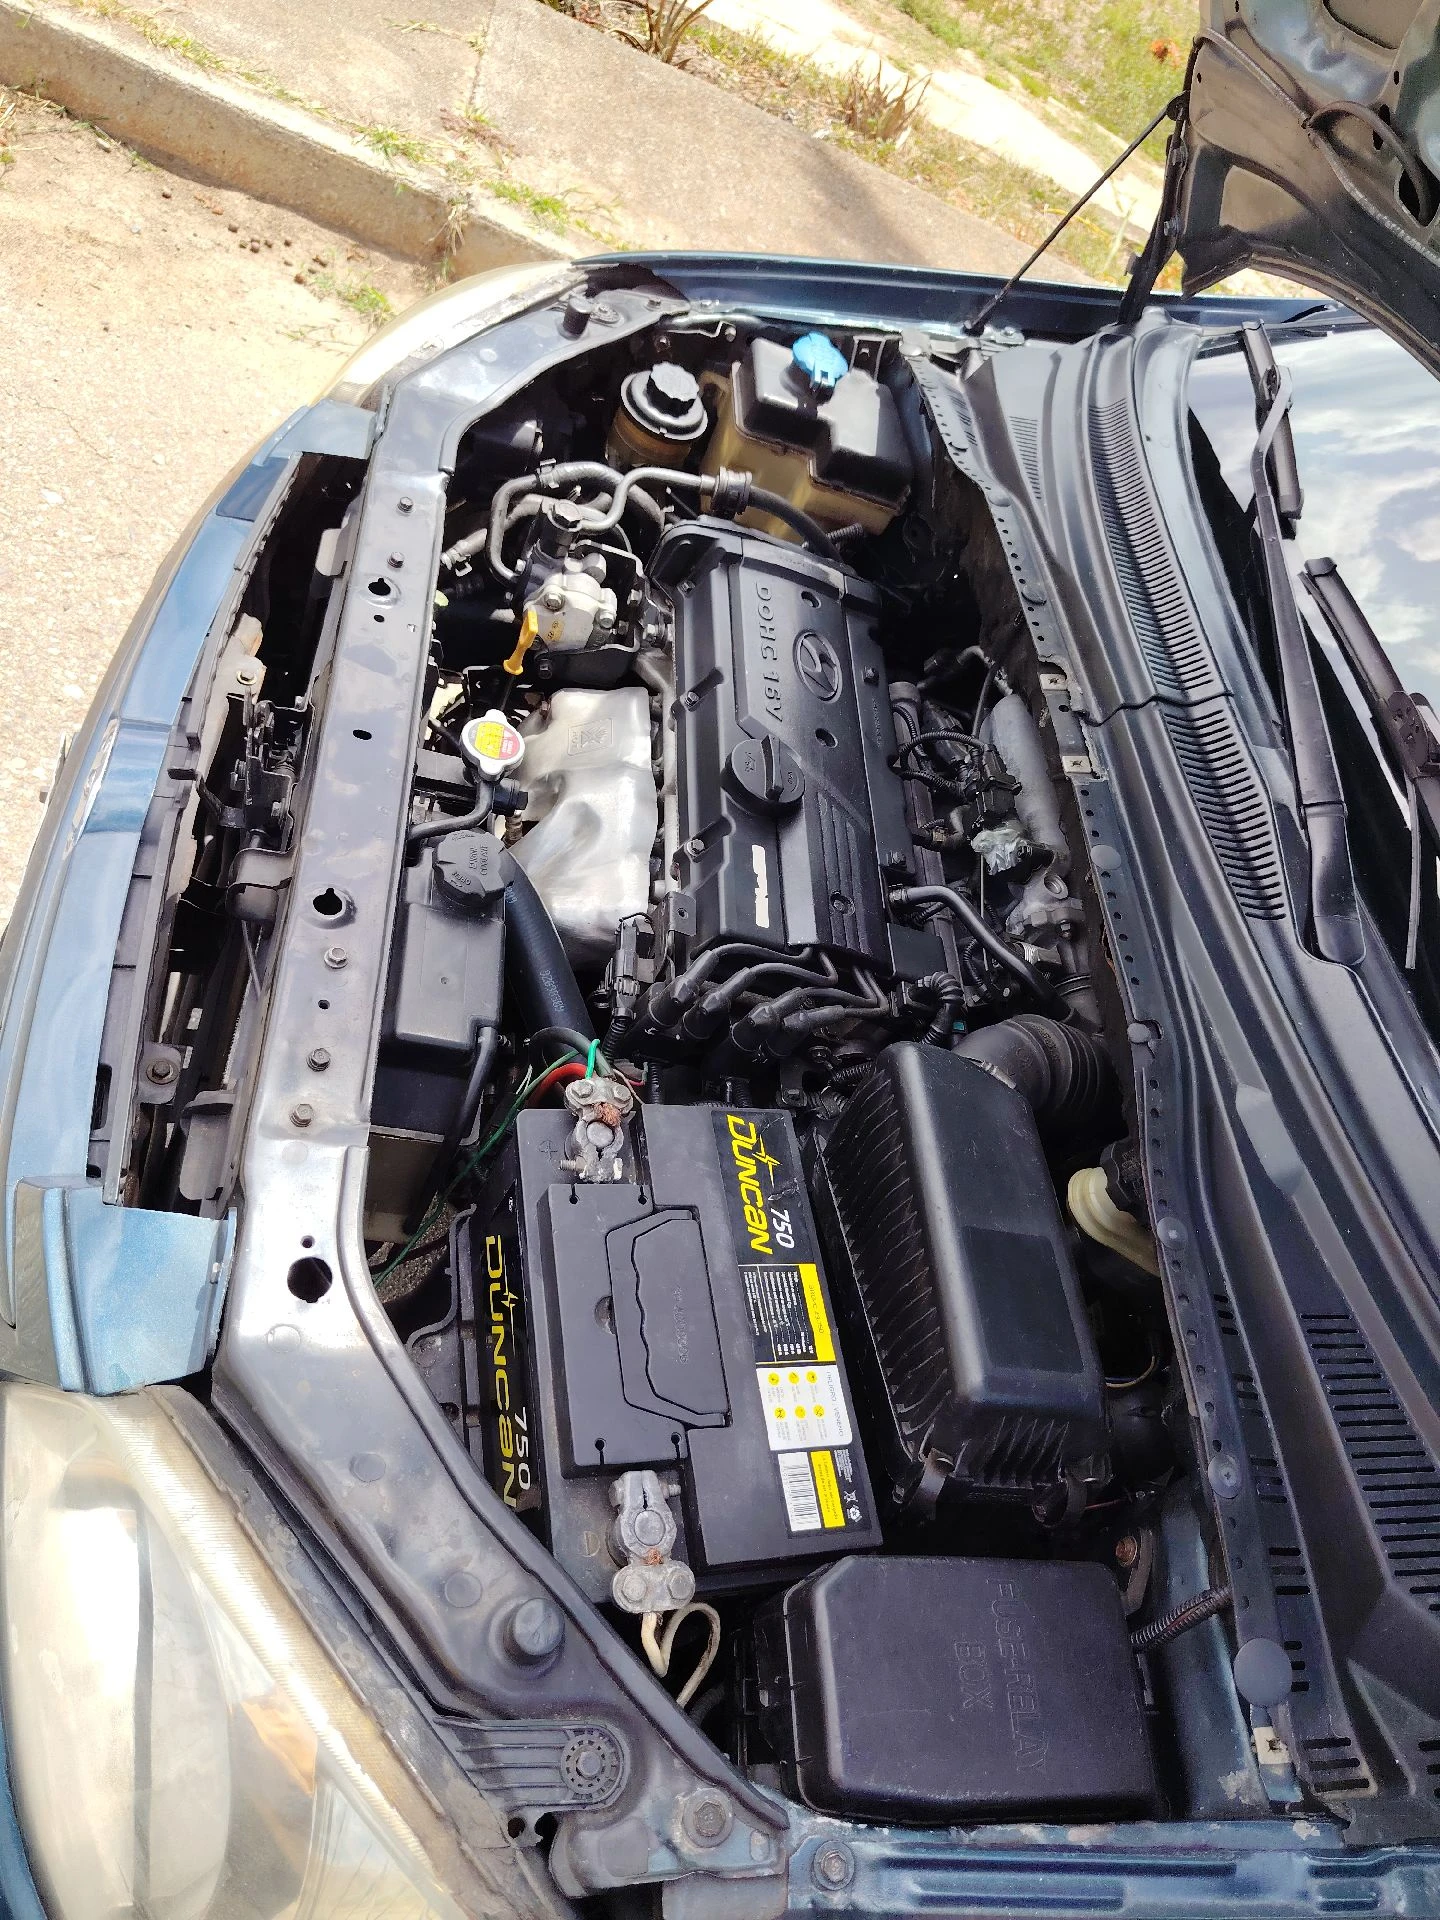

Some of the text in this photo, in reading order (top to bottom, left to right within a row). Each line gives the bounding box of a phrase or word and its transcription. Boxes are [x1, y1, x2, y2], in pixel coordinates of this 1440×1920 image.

[755, 581, 783, 722] DOHC 16V
[770, 1208, 795, 1249] 750
[514, 1406, 532, 1490] 750
[954, 1641, 994, 1712] BOX
